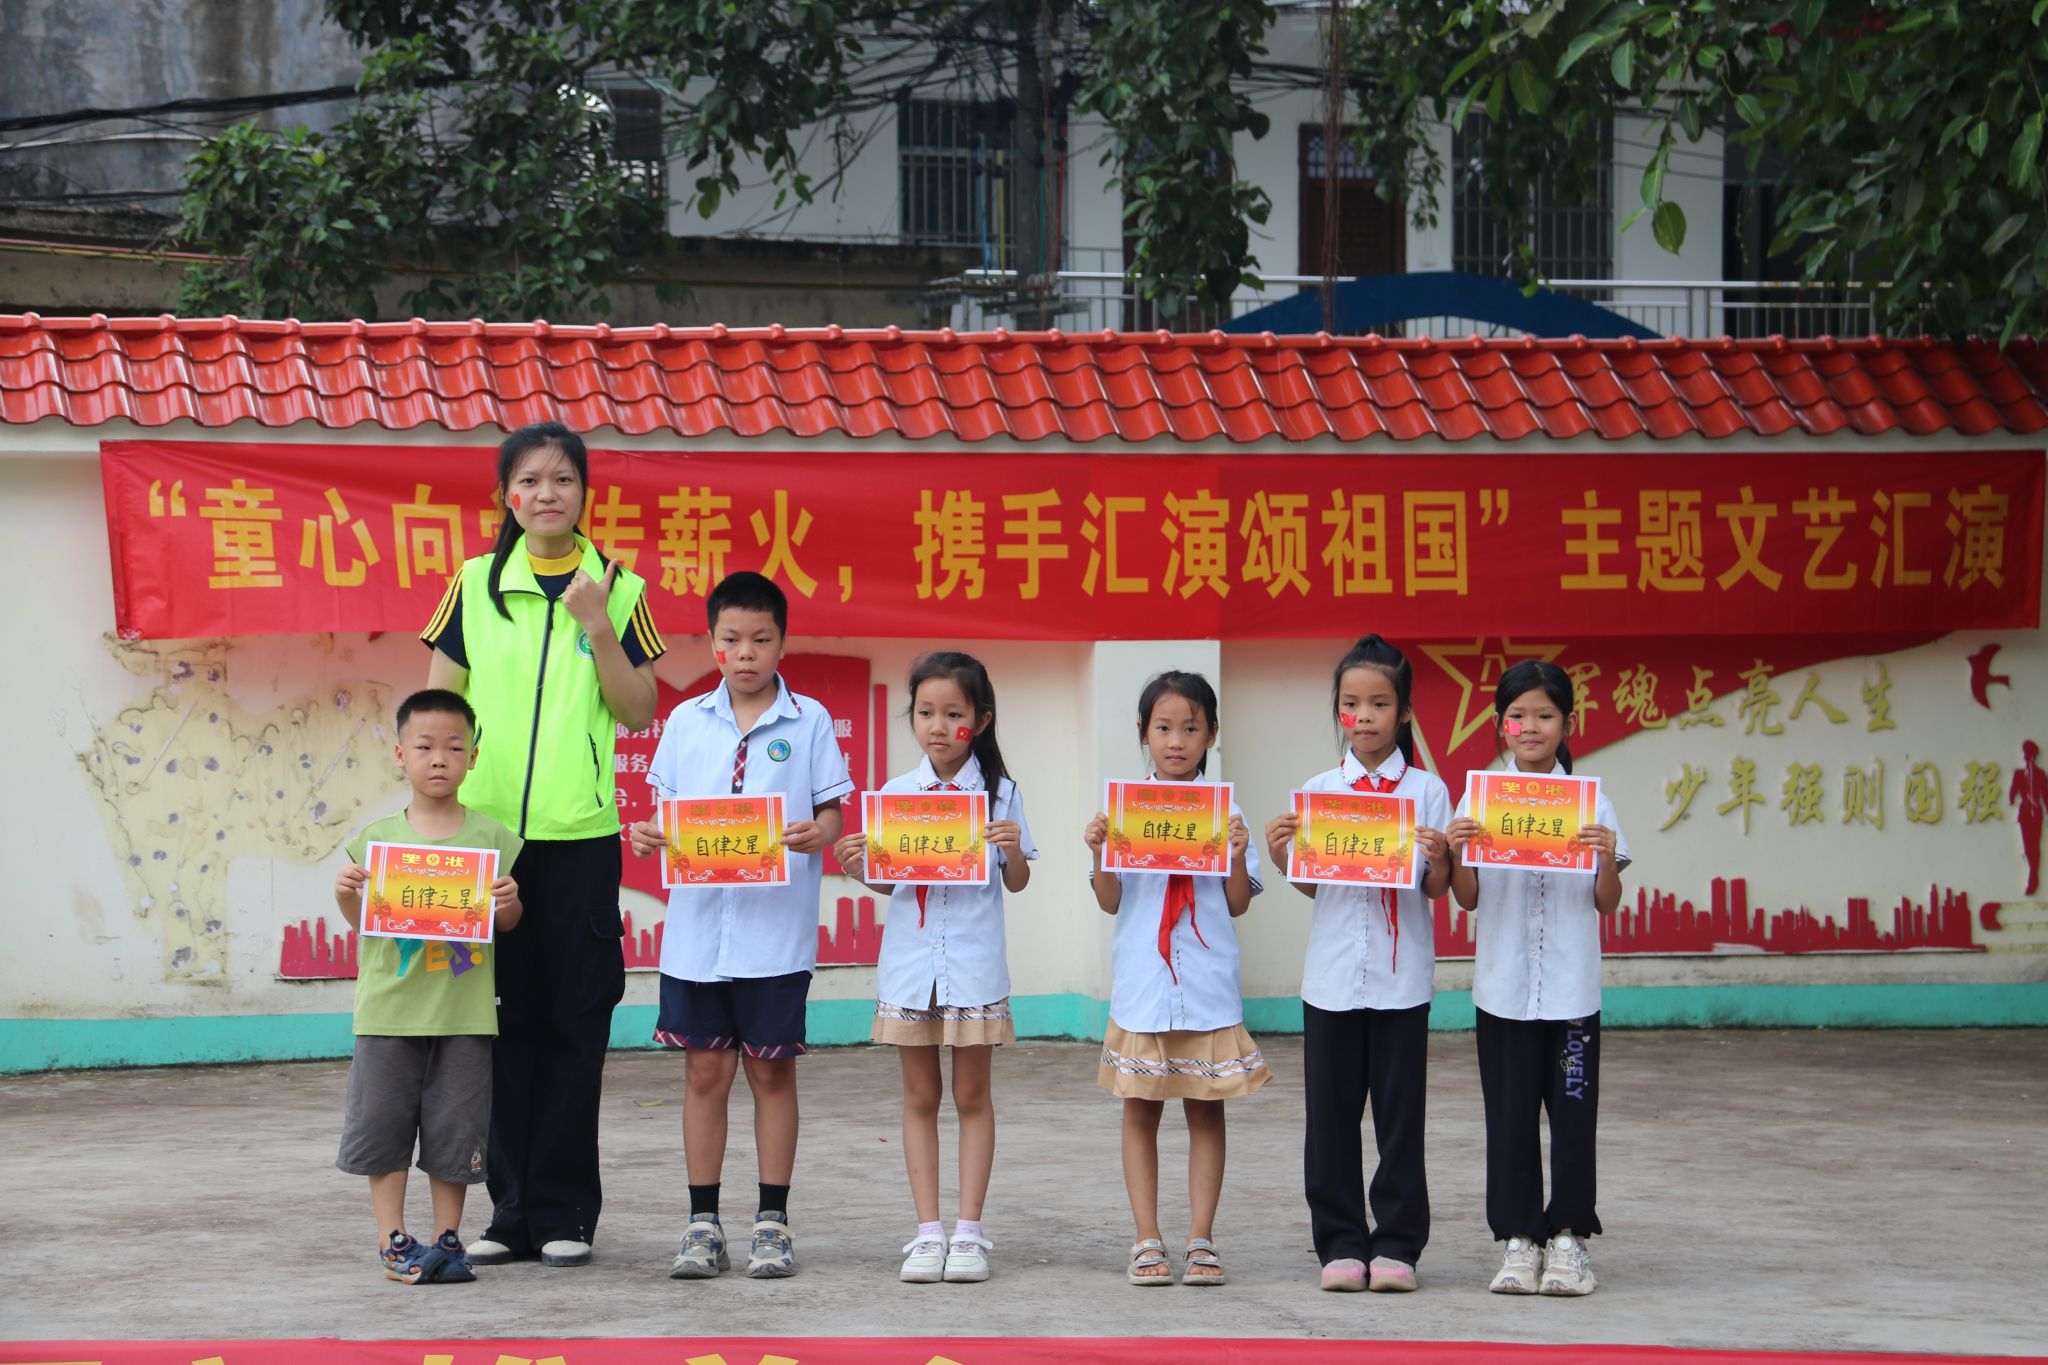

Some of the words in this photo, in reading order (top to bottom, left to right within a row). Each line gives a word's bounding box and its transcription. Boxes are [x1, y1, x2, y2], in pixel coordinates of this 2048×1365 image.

[1658, 755, 2005, 836] 少年强则国强
[1143, 820, 1197, 841] 自律之星
[1501, 812, 1565, 838] 自律之星
[696, 835, 760, 857] 自律之星
[1325, 832, 1384, 859] 自律之星
[401, 885, 473, 910] 自律之星
[1565, 1029, 1584, 1100] LOVELY
